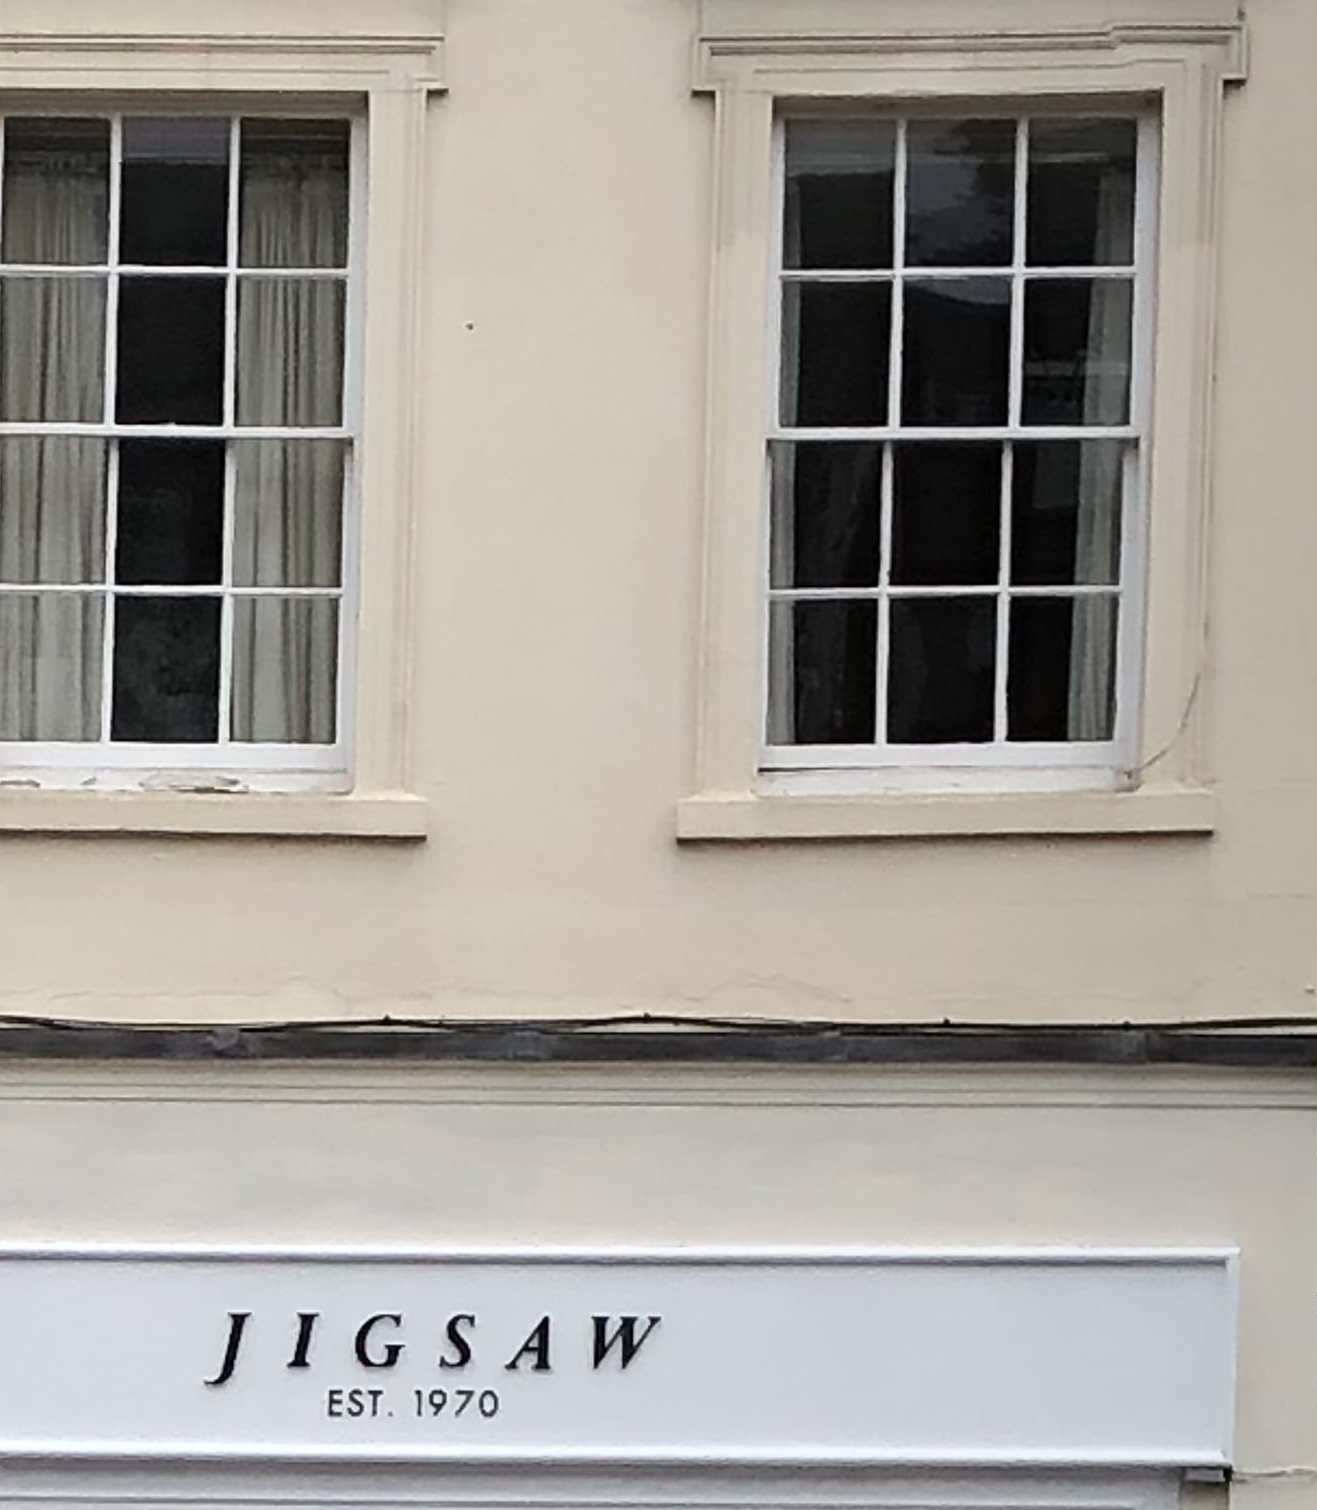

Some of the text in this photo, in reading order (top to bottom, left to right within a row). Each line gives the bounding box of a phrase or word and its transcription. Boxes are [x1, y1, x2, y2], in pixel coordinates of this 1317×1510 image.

[203, 1312, 662, 1386] JIGSAW
[327, 1389, 500, 1418] EST. 1970
